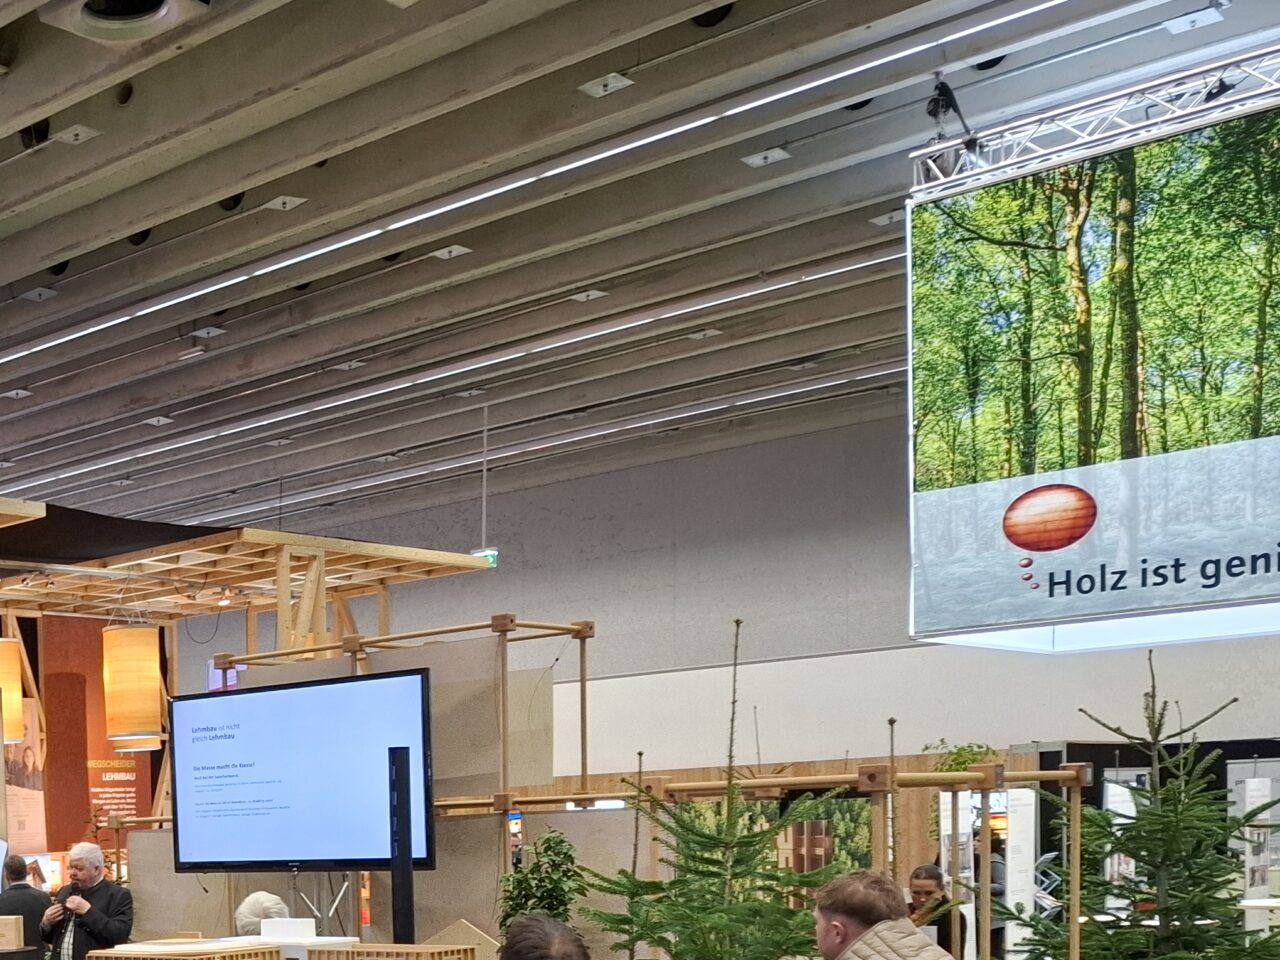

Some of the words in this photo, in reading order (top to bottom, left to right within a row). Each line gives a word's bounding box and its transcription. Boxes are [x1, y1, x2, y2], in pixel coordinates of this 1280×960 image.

[1048, 563, 1128, 598] Holz
[1140, 557, 1187, 588] ist
[102, 772, 136, 781] LEHMBAU
